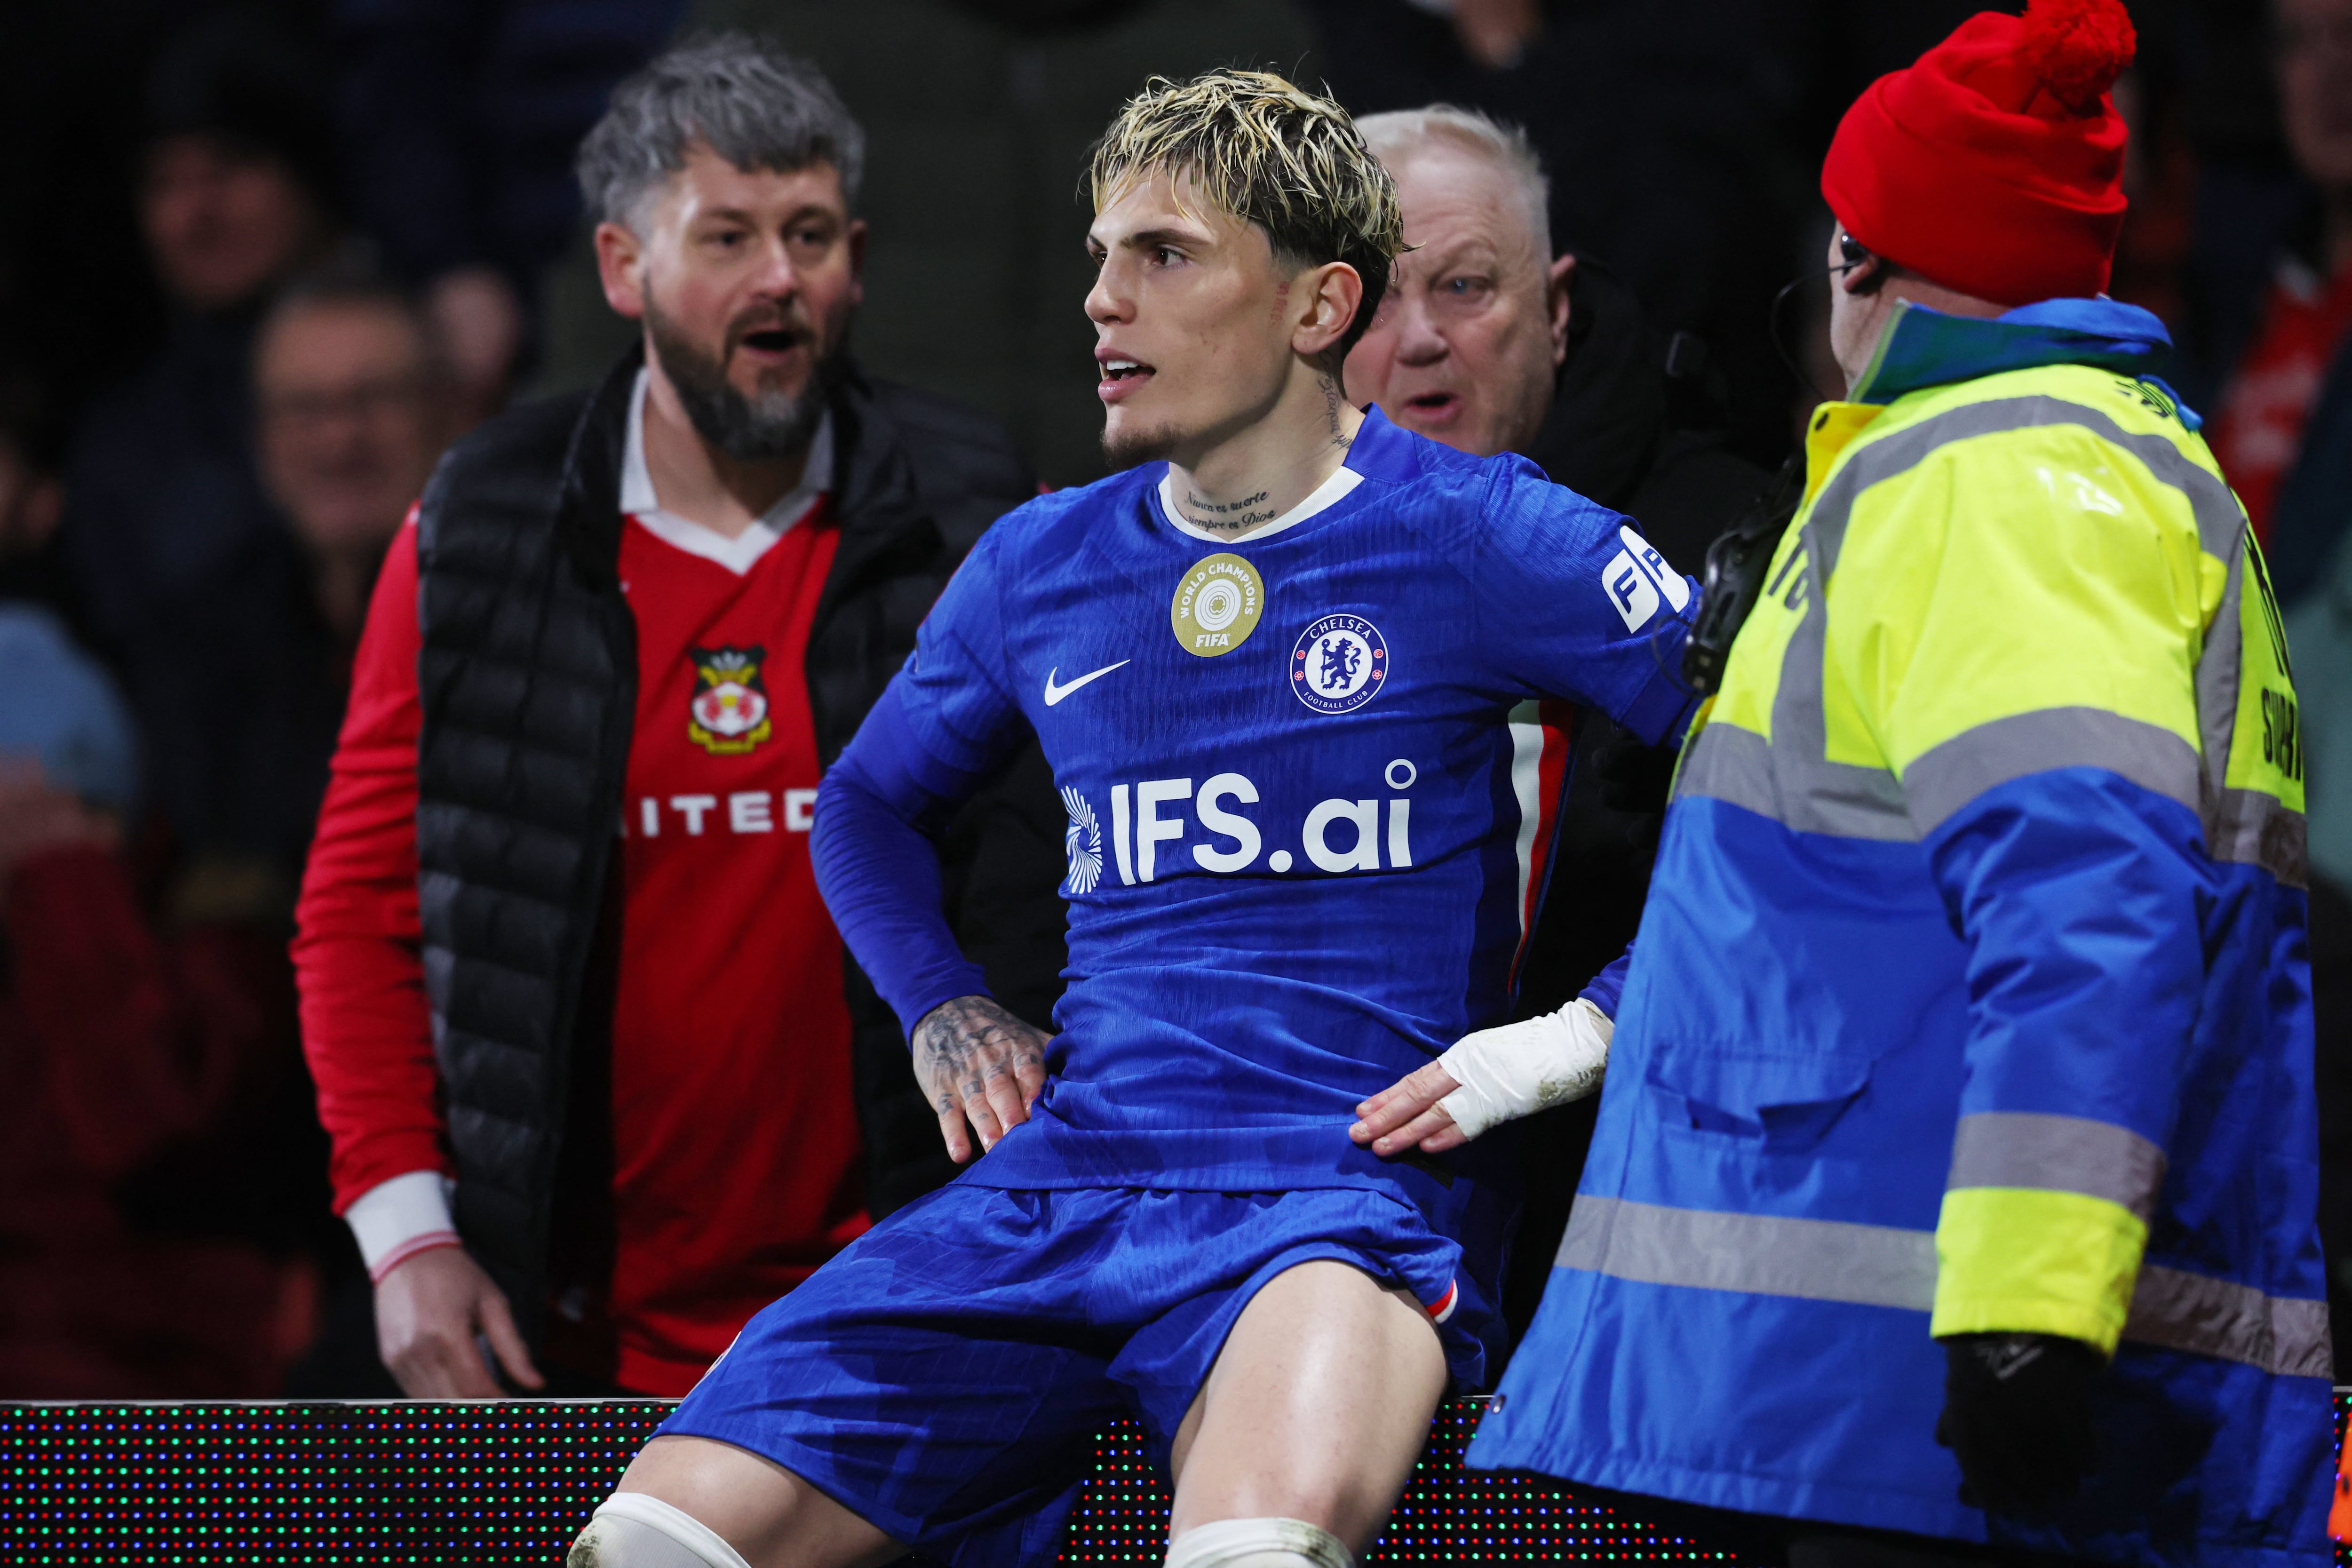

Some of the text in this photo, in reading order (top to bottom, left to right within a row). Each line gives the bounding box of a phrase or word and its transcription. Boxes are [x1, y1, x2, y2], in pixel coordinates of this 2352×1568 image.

[1242, 510, 1277, 527] Dios
[1180, 563, 1256, 619] WORLD CHAMPIONS
[1310, 618, 1372, 639] CHELSEA
[1195, 633, 1229, 648] FIFA
[1303, 690, 1368, 708] FOOTBALL CLUB
[1111, 758, 1417, 886] IFS.ai
